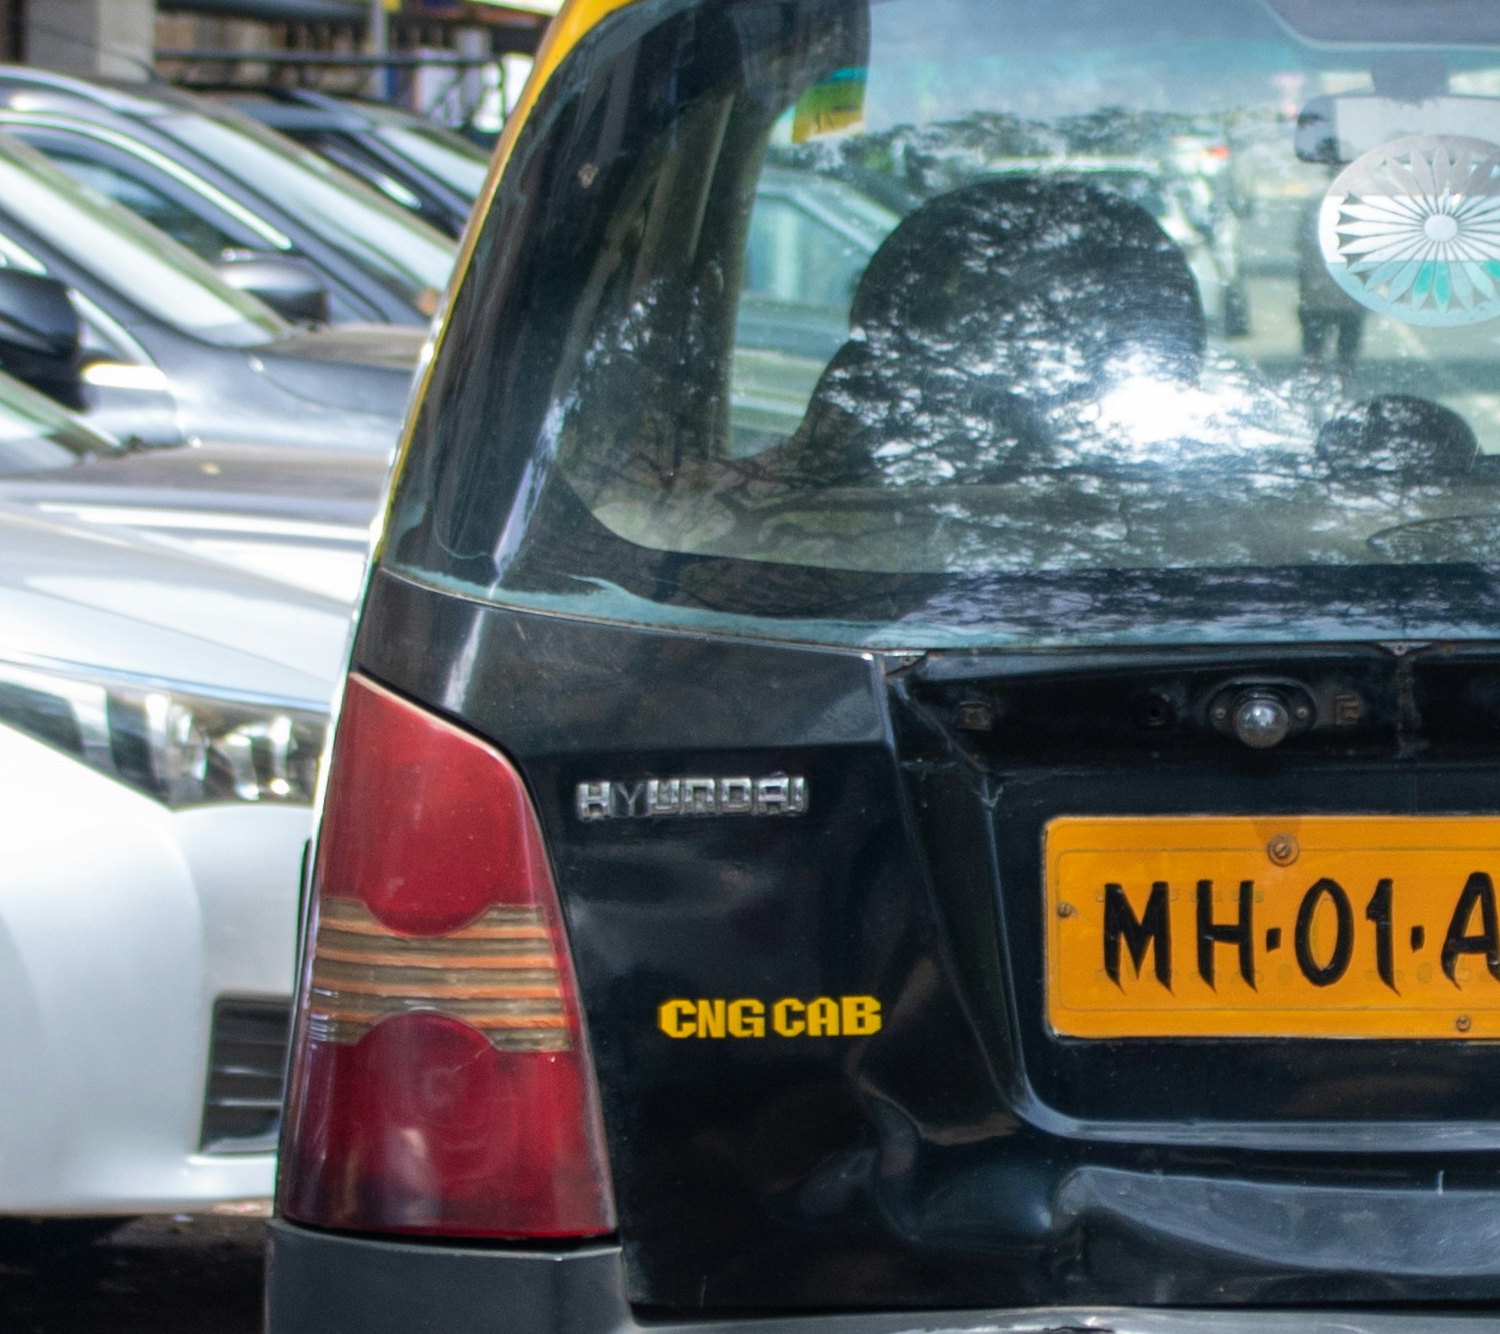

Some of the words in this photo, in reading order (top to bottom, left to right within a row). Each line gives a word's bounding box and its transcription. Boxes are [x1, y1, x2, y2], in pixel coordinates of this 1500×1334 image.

[576, 774, 809, 822] HYUNDAI
[659, 998, 766, 1039] CNG
[772, 995, 882, 1038] CAB
